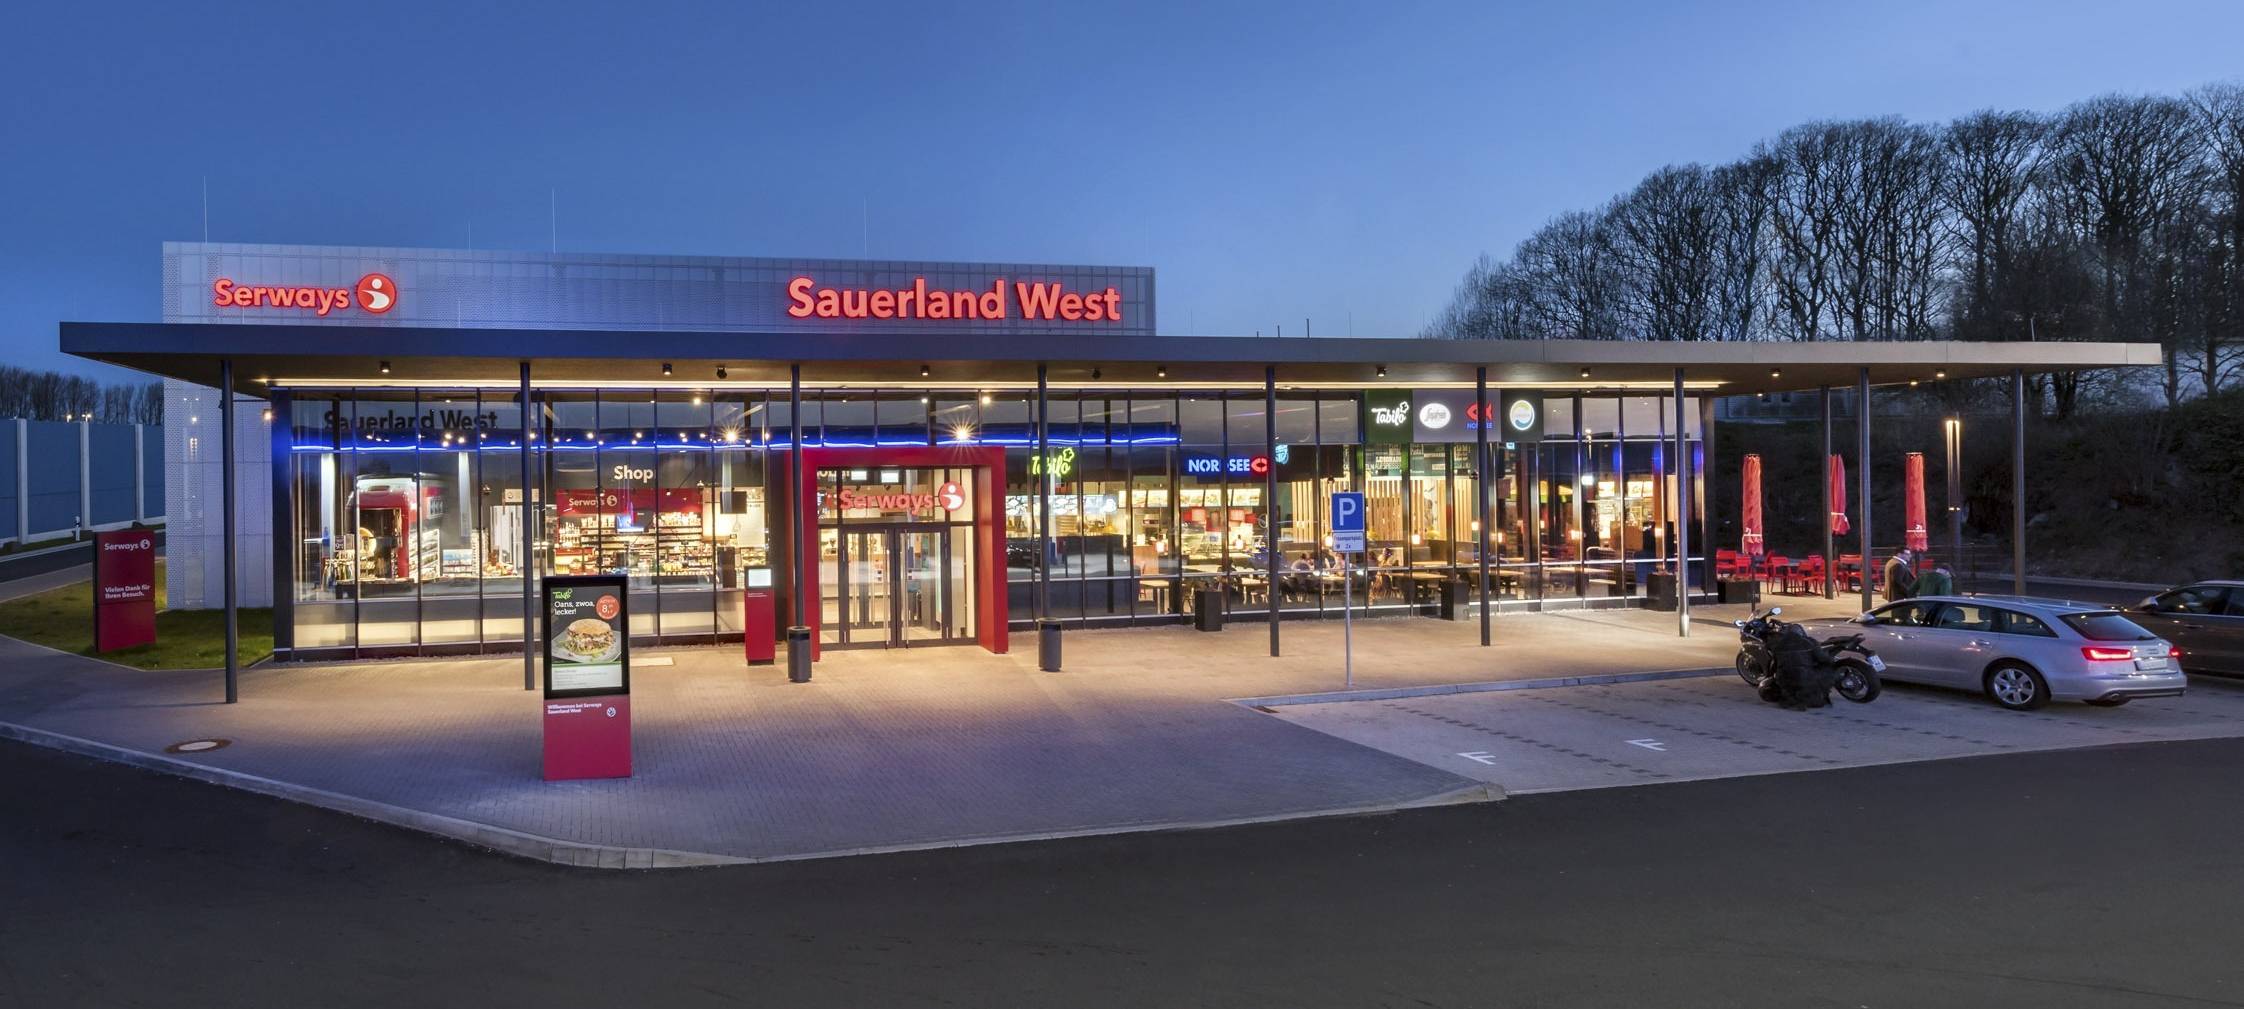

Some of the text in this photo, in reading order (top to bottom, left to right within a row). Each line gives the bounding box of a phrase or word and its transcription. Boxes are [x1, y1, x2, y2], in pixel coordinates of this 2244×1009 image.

[214, 278, 349, 315] Serways
[788, 276, 1121, 320] Sauerland West
[613, 465, 653, 483] Shop
[1188, 459, 1250, 473] NORSEE
[839, 488, 935, 517] Serways
[1339, 497, 1356, 526] P
[104, 542, 139, 551] Serways
